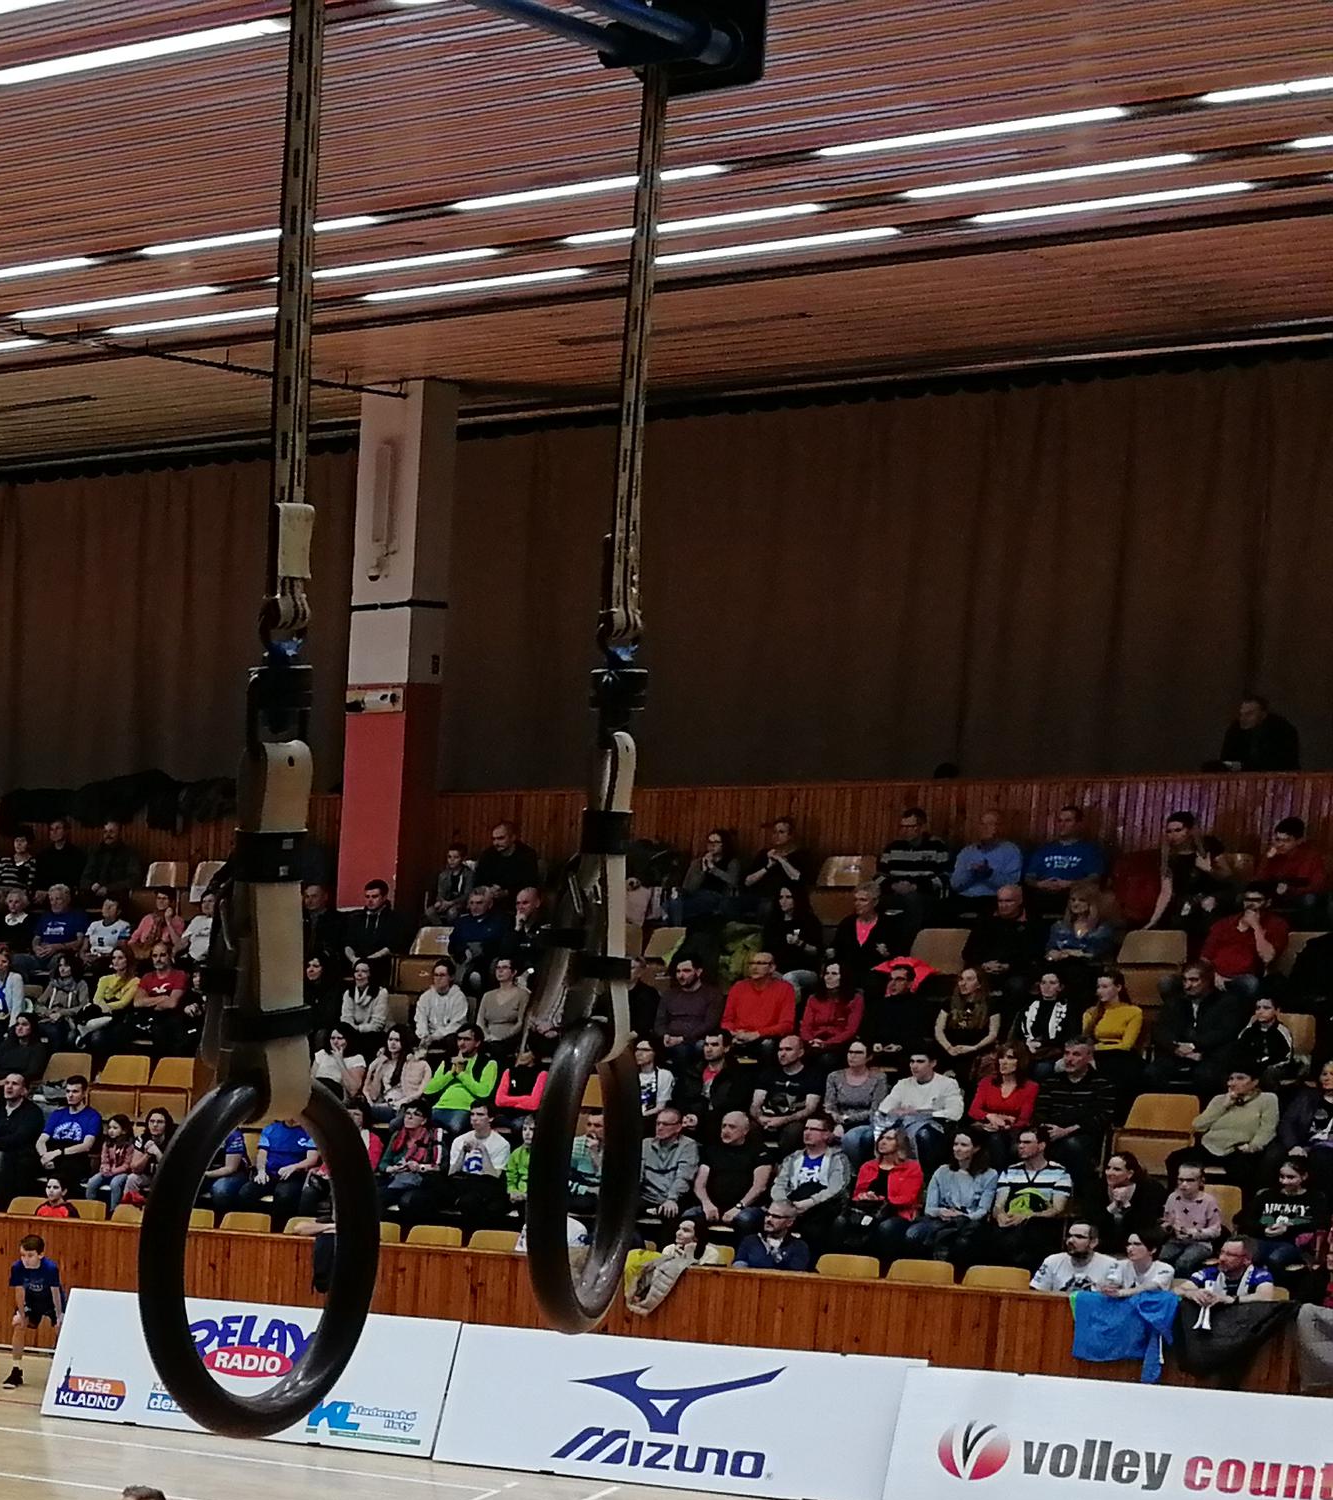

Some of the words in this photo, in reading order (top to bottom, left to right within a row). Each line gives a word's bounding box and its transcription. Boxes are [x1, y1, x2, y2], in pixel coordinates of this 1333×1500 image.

[215, 1352, 282, 1374] RADIO
[78, 1379, 111, 1394] Vaše
[59, 1392, 118, 1410] KLADNO
[550, 1426, 766, 1479] MIZUNO
[1023, 1439, 1172, 1491] volley
